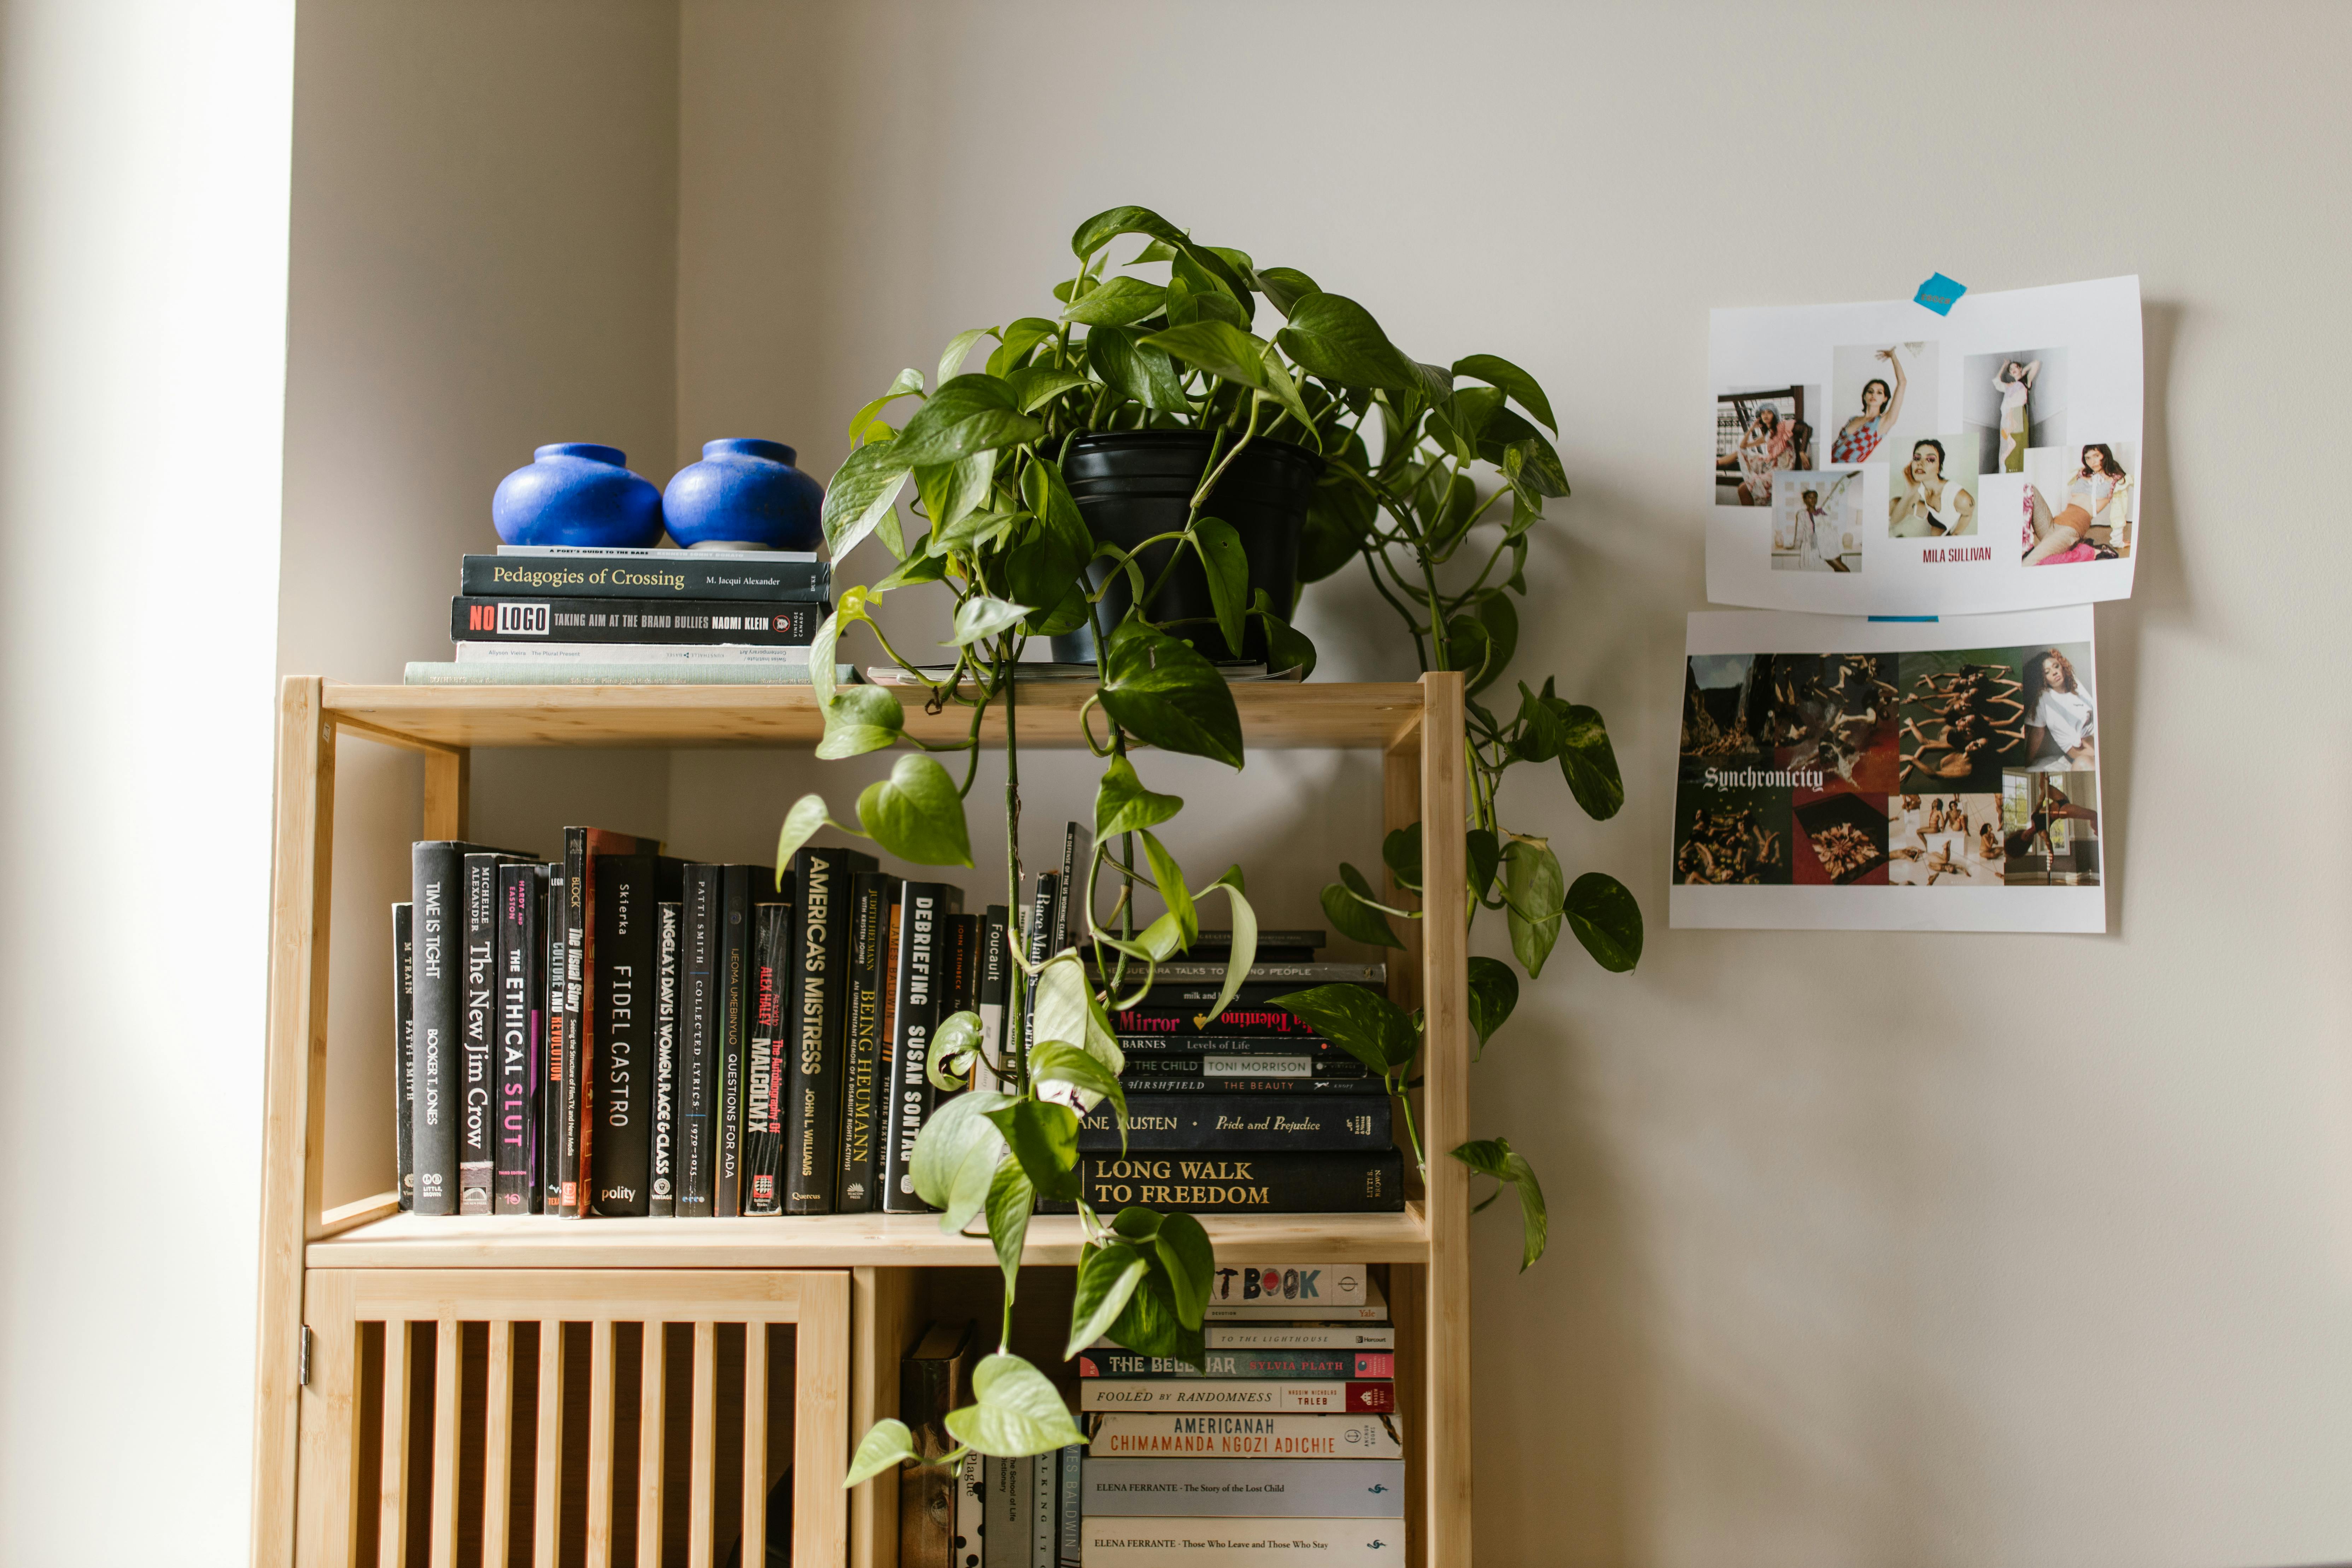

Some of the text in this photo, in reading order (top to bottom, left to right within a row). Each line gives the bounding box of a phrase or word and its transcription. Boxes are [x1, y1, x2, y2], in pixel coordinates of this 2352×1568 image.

[1923, 546, 1991, 563] MILA SULLIVAN
[493, 566, 685, 591] Pedagogies of Crossing
[706, 576, 780, 586] M. Jacqui Alexander
[469, 605, 769, 631] NO LOGO TAKING AIM AT THE BRAND BULLIES NAOMI KLEIN
[1703, 765, 1824, 792] Synchronicity
[471, 866, 480, 932] ALEXANDER
[481, 867, 490, 924] MICHELLE
[571, 877, 580, 908] BLOCK
[619, 884, 629, 935] Skierka
[426, 881, 440, 979] TIME IS TIGHT
[696, 881, 706, 964] PATTI SMITH
[866, 889, 878, 971] JUDITH HEUMANN
[565, 928, 583, 1013] The Visual Story
[800, 855, 830, 1075] AMERICA'S MISTRESS
[909, 897, 933, 1005] DEBRIEFING
[955, 949, 963, 990] STEINBECK
[988, 923, 1003, 981] Foucault
[729, 948, 739, 1045] IJEOMA UMEBINYUO
[759, 966, 773, 1026] ALEX HALEY
[772, 994, 780, 1004] As
[656, 908, 676, 1175] ANGELA Y. DAVIS WOMEN, RACE & CLASS
[1119, 1011, 1180, 1031] Mirror
[1221, 1012, 1291, 1032] Tolentino
[464, 941, 493, 1149] The New Jim Crow
[504, 949, 524, 1147] THE ETHICAL SLUT
[609, 965, 631, 1127] FIDEL CASTRO
[905, 1025, 926, 1084] SUSAN
[1123, 1040, 1166, 1048] BARNES
[1187, 1041, 1250, 1049] Levels of Life
[426, 1028, 438, 1125] BOOKER T. JONES
[748, 1037, 771, 1133] MALCOLM X
[768, 1039, 784, 1134] The Autobiography Of
[852, 990, 876, 1163] BEING HEUMANN
[1128, 1081, 1205, 1091] HIRSHFIELD
[1136, 1061, 1157, 1070] THE
[1161, 1061, 1198, 1070] CHILD
[1208, 1062, 1237, 1071] TONI
[1241, 1062, 1306, 1072] MORRISON
[725, 1053, 738, 1178] QUESTIONS FOR ADA
[802, 1088, 815, 1176] JOHN L. WILLIAMS
[900, 1091, 922, 1162] SONTAG
[1215, 1116, 1320, 1133] Pride and Prejudice
[1095, 1160, 1254, 1180] LONG WALK
[602, 1186, 636, 1202] polity
[792, 1192, 821, 1201] Quercus
[1095, 1184, 1270, 1204] TO FREEDOM
[1244, 1268, 1322, 1300] BOOK
[1249, 1361, 1344, 1370] SYLVIA PLATH
[1096, 1392, 1153, 1402] FOOLED
[1176, 1392, 1272, 1402] RANDOMNESS
[1111, 1435, 1335, 1453] CHIMAMANDA NGOZI ADICHIE
[1174, 1417, 1274, 1434] AMERICANAH
[964, 1453, 977, 1497] Plague
[1200, 1484, 1220, 1493] Story
